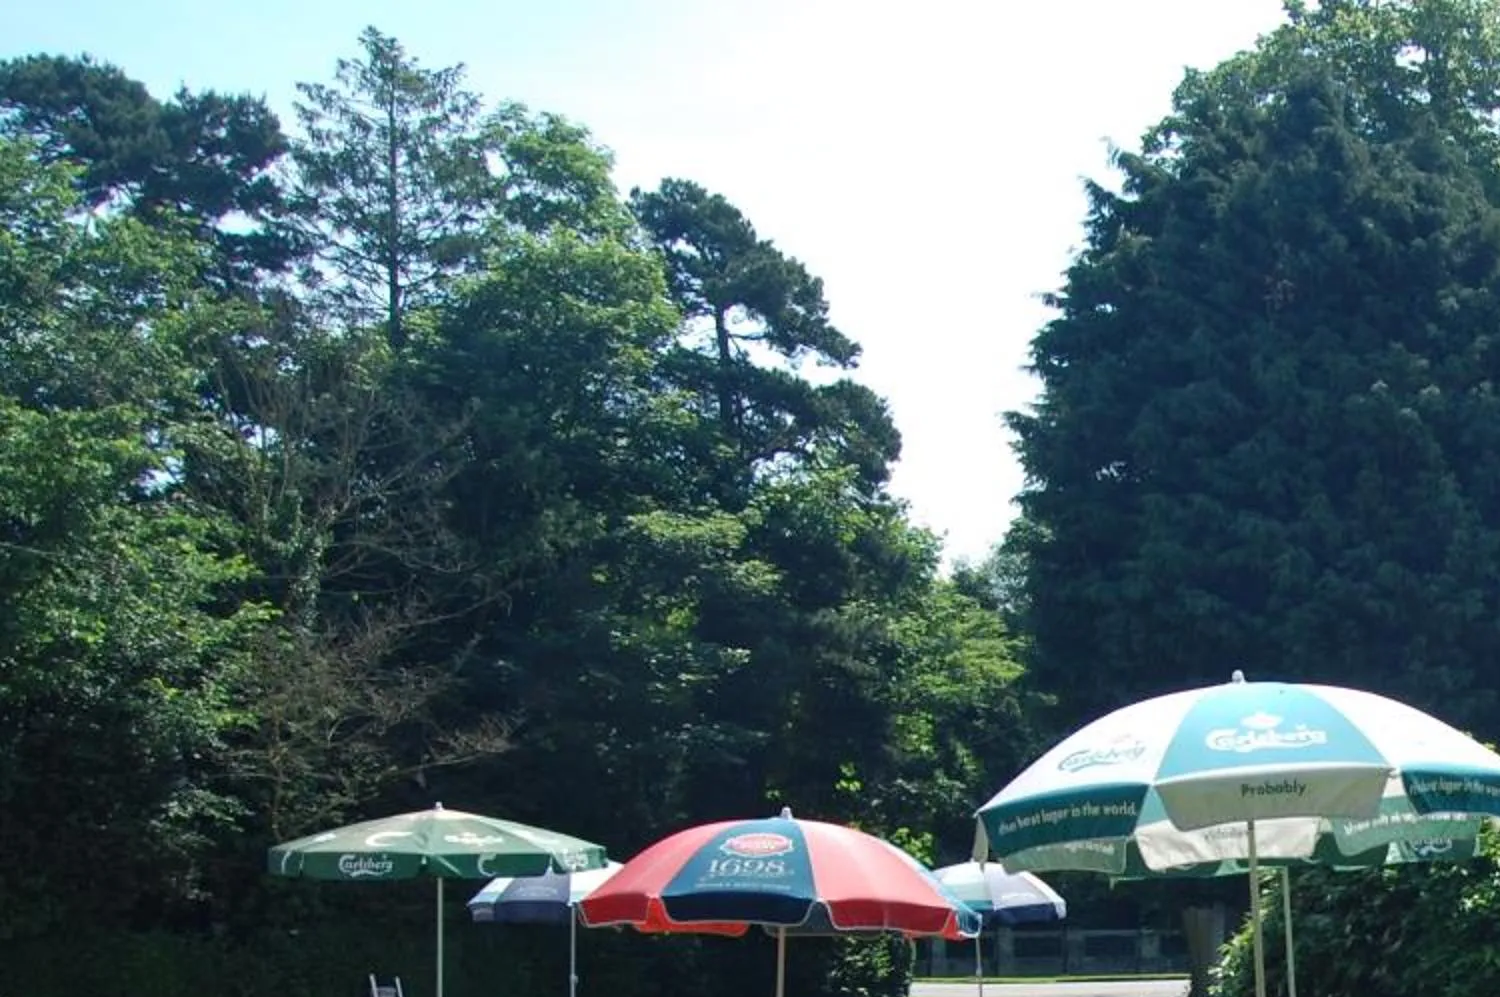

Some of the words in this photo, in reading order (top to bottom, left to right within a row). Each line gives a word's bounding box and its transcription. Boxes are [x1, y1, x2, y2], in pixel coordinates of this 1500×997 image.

[1241, 779, 1306, 798] Probably
[1042, 807, 1068, 826] lager
[1081, 801, 1101, 816] the
[339, 854, 393, 877] Carlsberg
[709, 859, 786, 877] 1698
